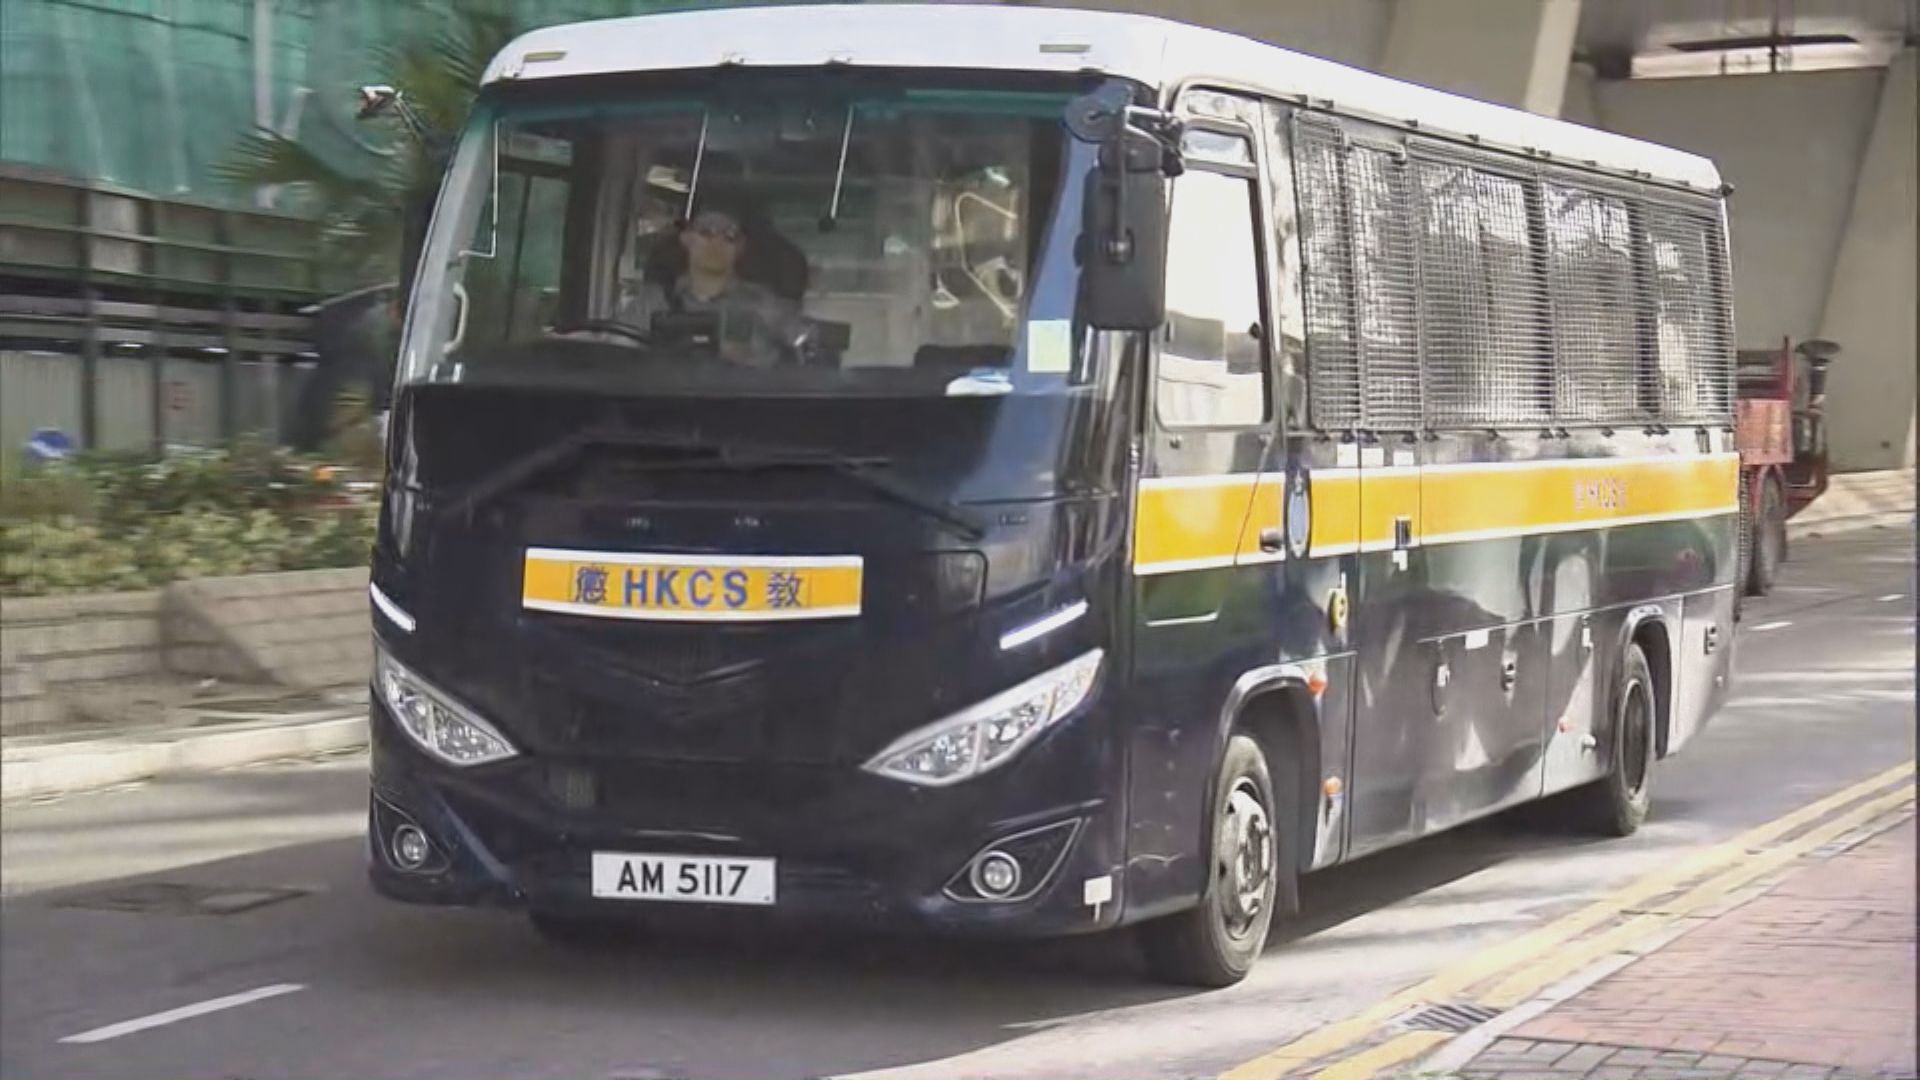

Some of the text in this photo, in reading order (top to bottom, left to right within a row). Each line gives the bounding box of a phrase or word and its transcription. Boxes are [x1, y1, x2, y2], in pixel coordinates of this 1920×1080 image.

[622, 568, 750, 609] HKCS
[617, 861, 750, 896] AM 5117
